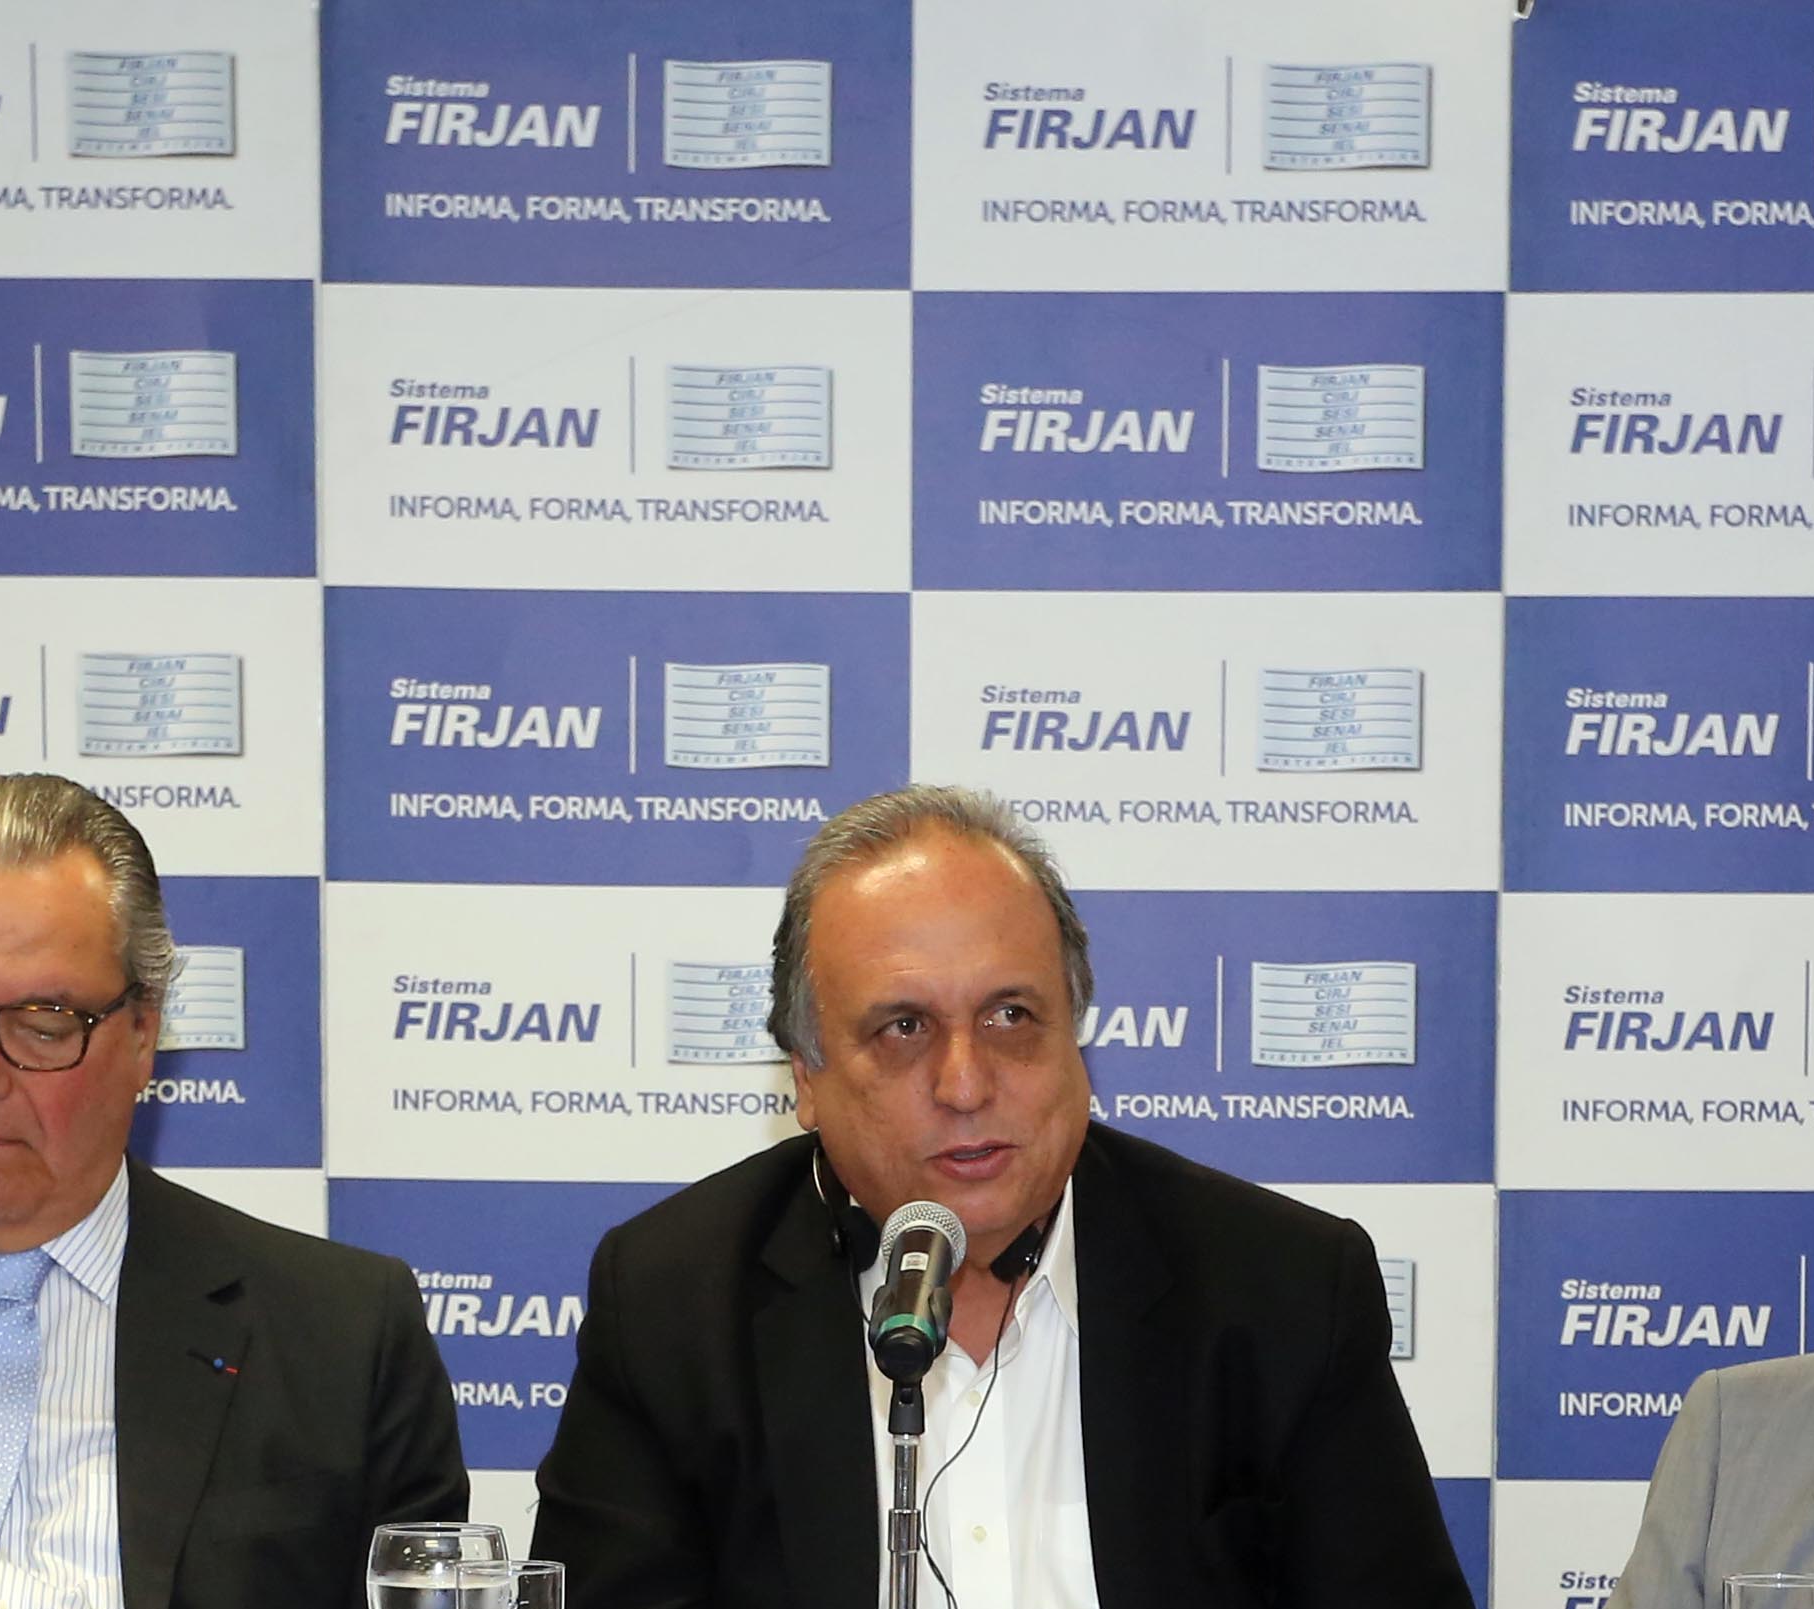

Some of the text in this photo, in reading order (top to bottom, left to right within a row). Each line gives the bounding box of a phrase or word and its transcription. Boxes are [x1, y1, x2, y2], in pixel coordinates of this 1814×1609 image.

[1573, 82, 1678, 104] Sistema
[385, 104, 601, 148] FIRJAN
[983, 108, 1197, 150] FIRJAN
[1572, 109, 1790, 153] FIRJAN
[390, 404, 601, 448] FIRJAN
[979, 409, 1195, 453] FIRJAN
[1570, 413, 1784, 455] FIRJAN
[389, 678, 492, 700] Sistema
[980, 684, 1081, 704] Sistema
[1565, 687, 1668, 708] Sistema
[390, 705, 602, 749] FIRJAN
[980, 710, 1191, 752] FIRJAN
[1565, 713, 1779, 756] FIRJAN
[1119, 800, 1418, 825] FORMA, TRANSFORMA.
[393, 975, 492, 996] Sistema
[1563, 985, 1665, 1005] Sistema
[393, 1000, 601, 1043] FIRJAN
[1563, 1011, 1775, 1052] FIRJAN
[392, 1088, 633, 1116] INFORMA, FORMA,
[1115, 1094, 1415, 1121] FORMA, TRANSFORMA.
[1562, 1099, 1805, 1126] INFORMA, FORMA,
[1560, 1279, 1661, 1300] Sistema
[1560, 1304, 1772, 1347] FIRJAN
